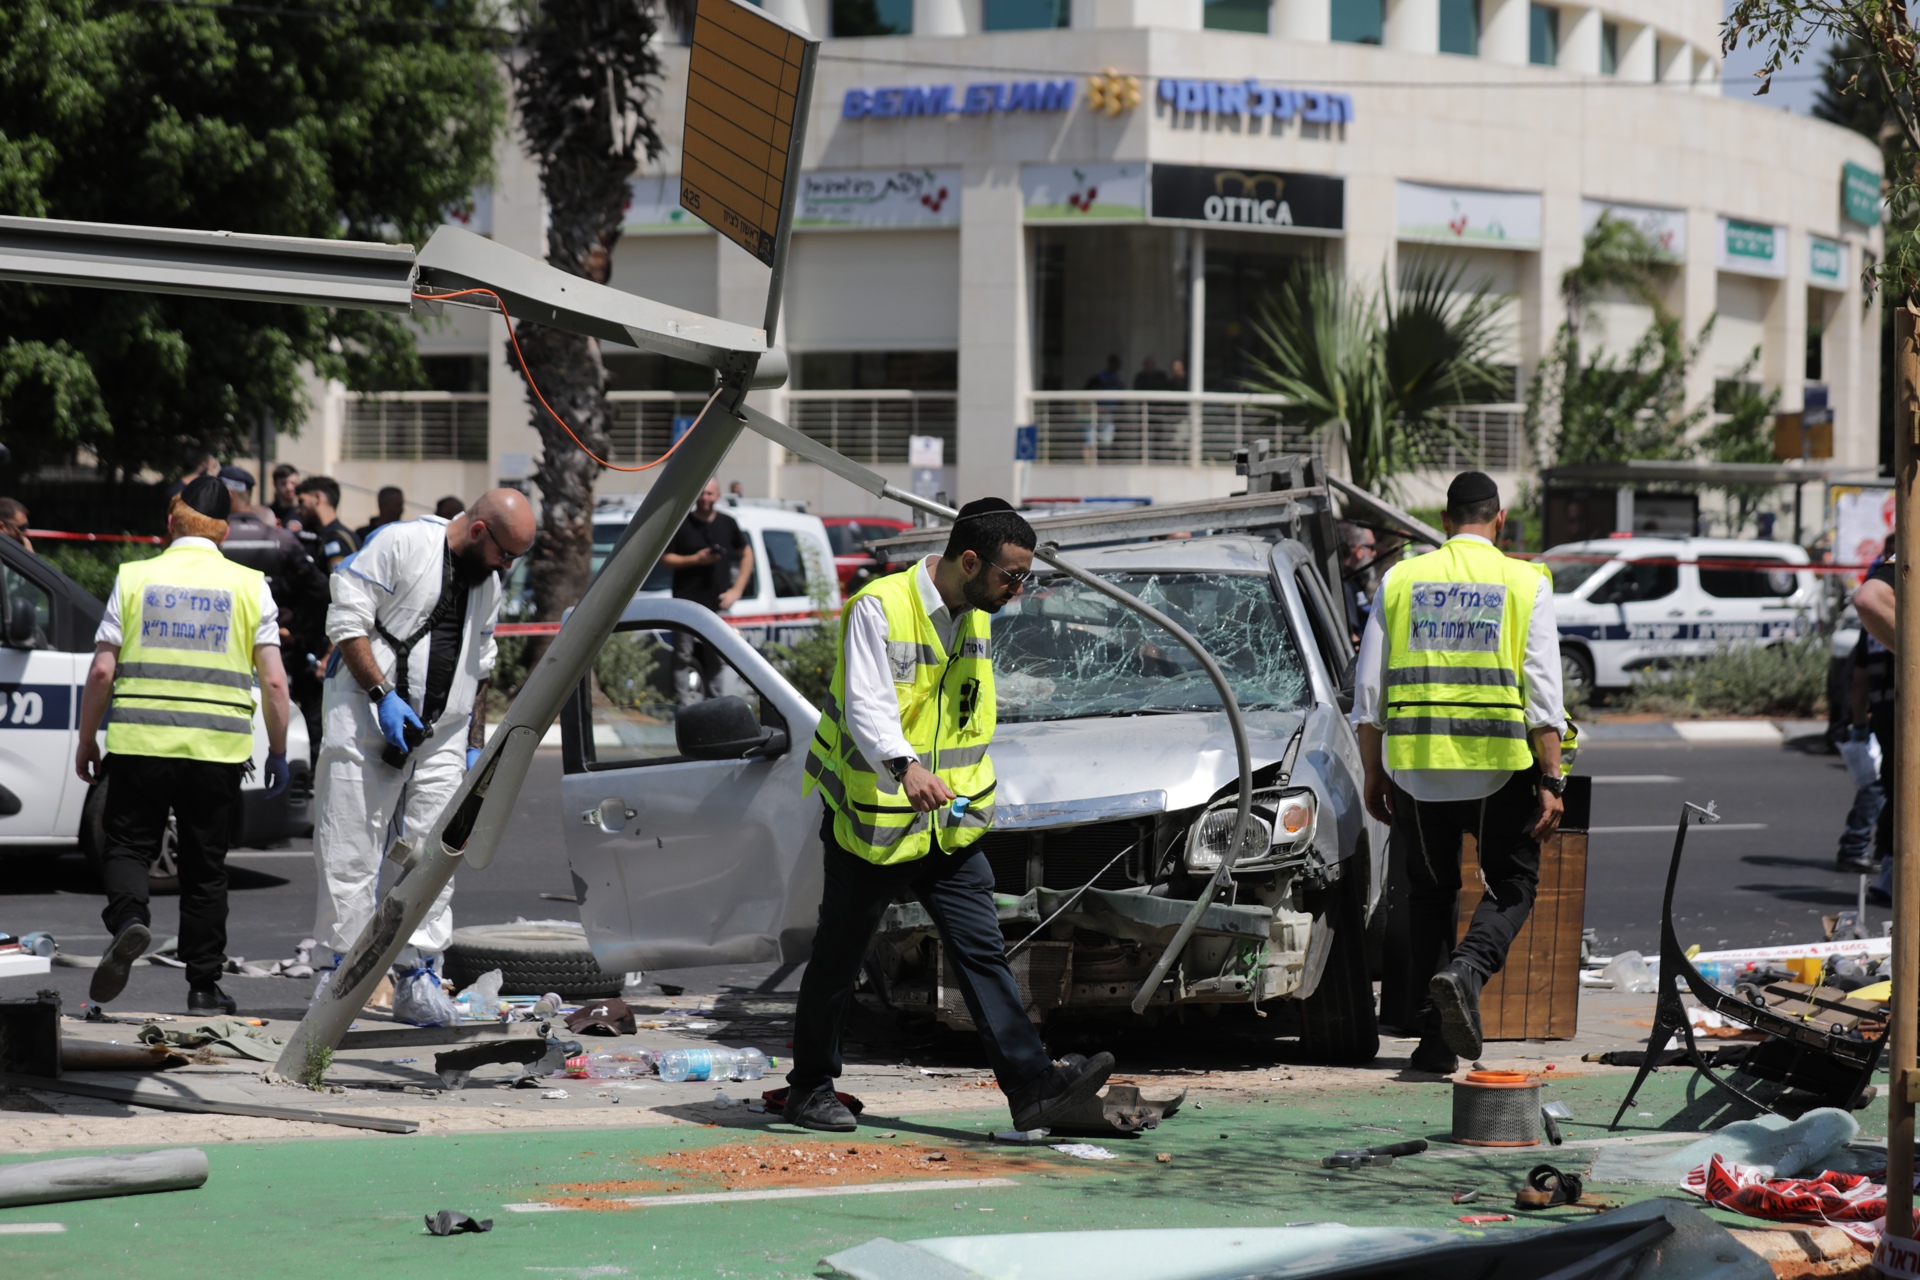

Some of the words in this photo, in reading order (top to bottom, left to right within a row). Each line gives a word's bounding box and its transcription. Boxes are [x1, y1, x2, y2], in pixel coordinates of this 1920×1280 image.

[1157, 76, 1354, 122] הבינלאומי
[682, 187, 700, 210] 425
[723, 209, 739, 229] לציון
[1203, 195, 1293, 226] OTTICA
[740, 220, 759, 242] ראשון
[172, 622, 196, 639] מחוז
[1440, 621, 1465, 639] מחוז
